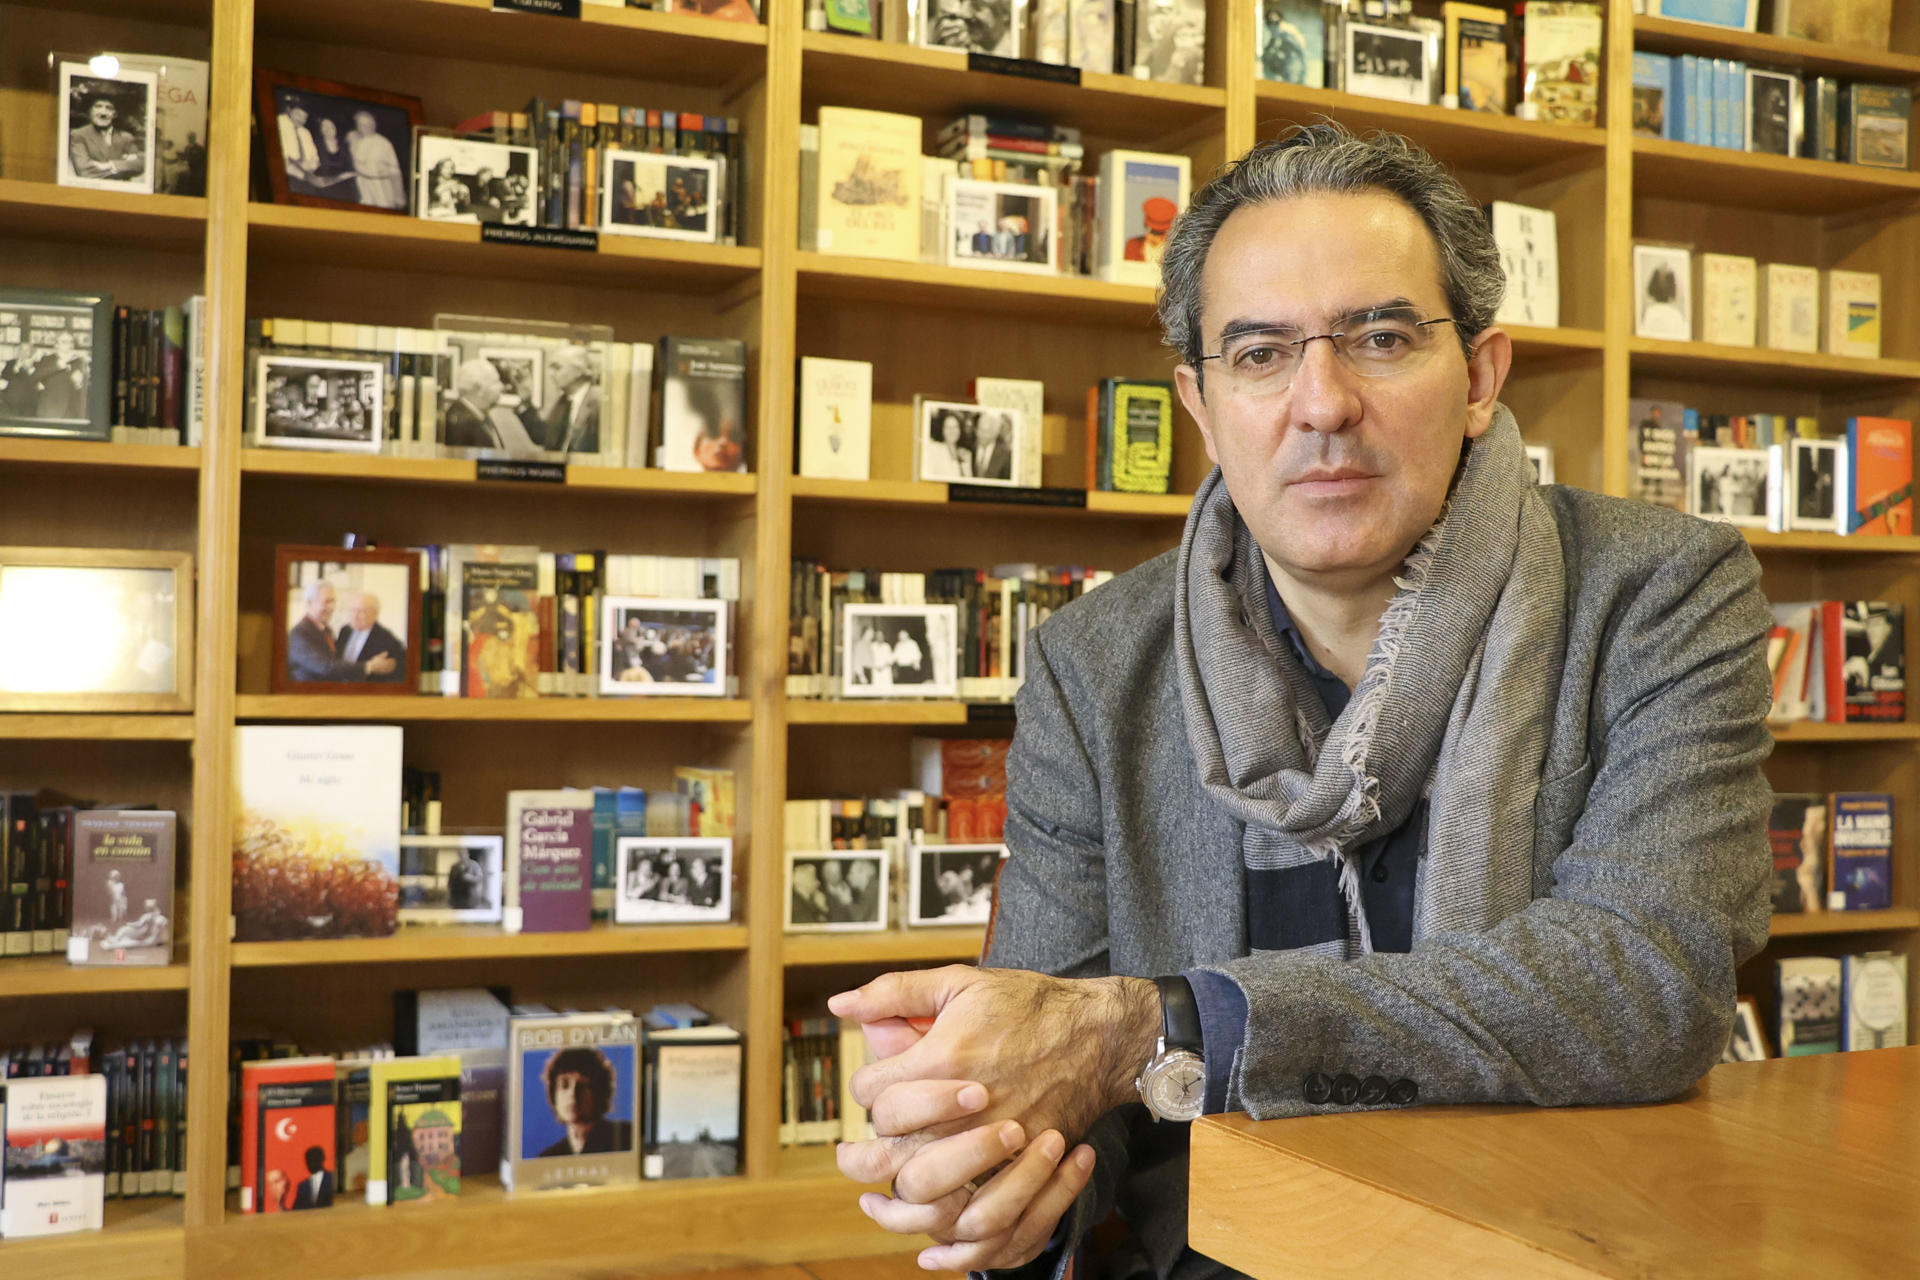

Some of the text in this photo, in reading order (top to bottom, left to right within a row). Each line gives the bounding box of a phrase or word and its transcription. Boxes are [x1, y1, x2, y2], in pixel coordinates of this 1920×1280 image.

[523, 809, 574, 828] Gabriel
[523, 826, 569, 844] García
[523, 842, 583, 863] Márquez
[521, 1024, 638, 1046] BOB DYLAN
